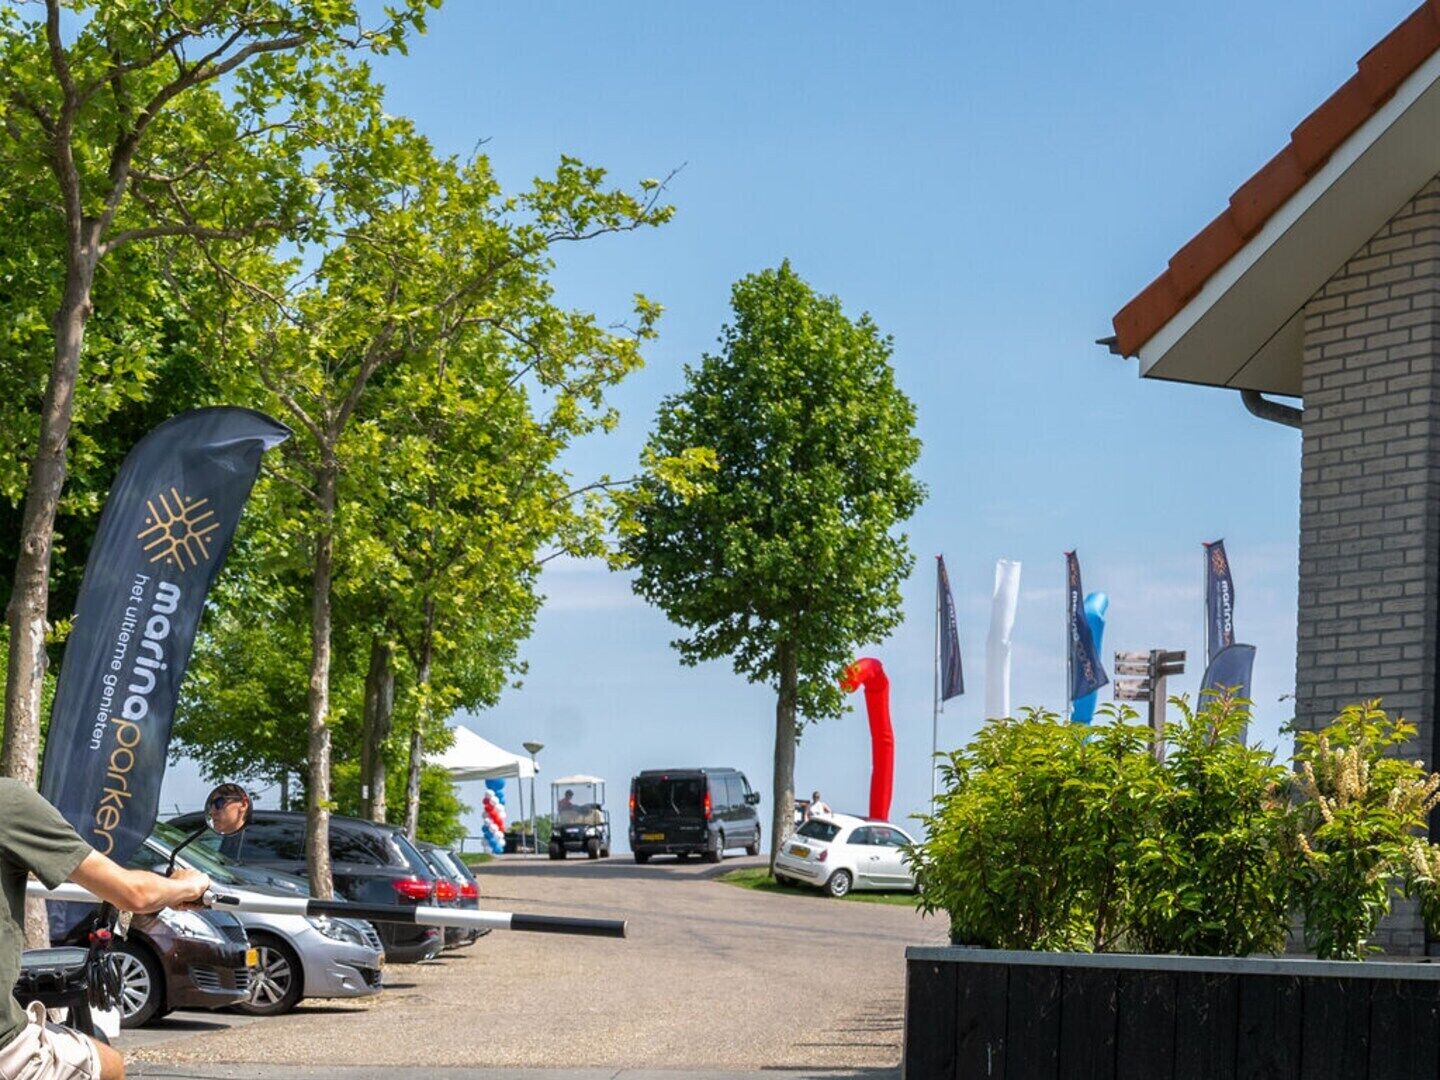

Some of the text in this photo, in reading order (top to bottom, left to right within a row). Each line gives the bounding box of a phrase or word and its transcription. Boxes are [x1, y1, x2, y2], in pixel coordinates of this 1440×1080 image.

[90, 573, 151, 750] het ultieme genieten
[94, 581, 181, 856] marinaparken
